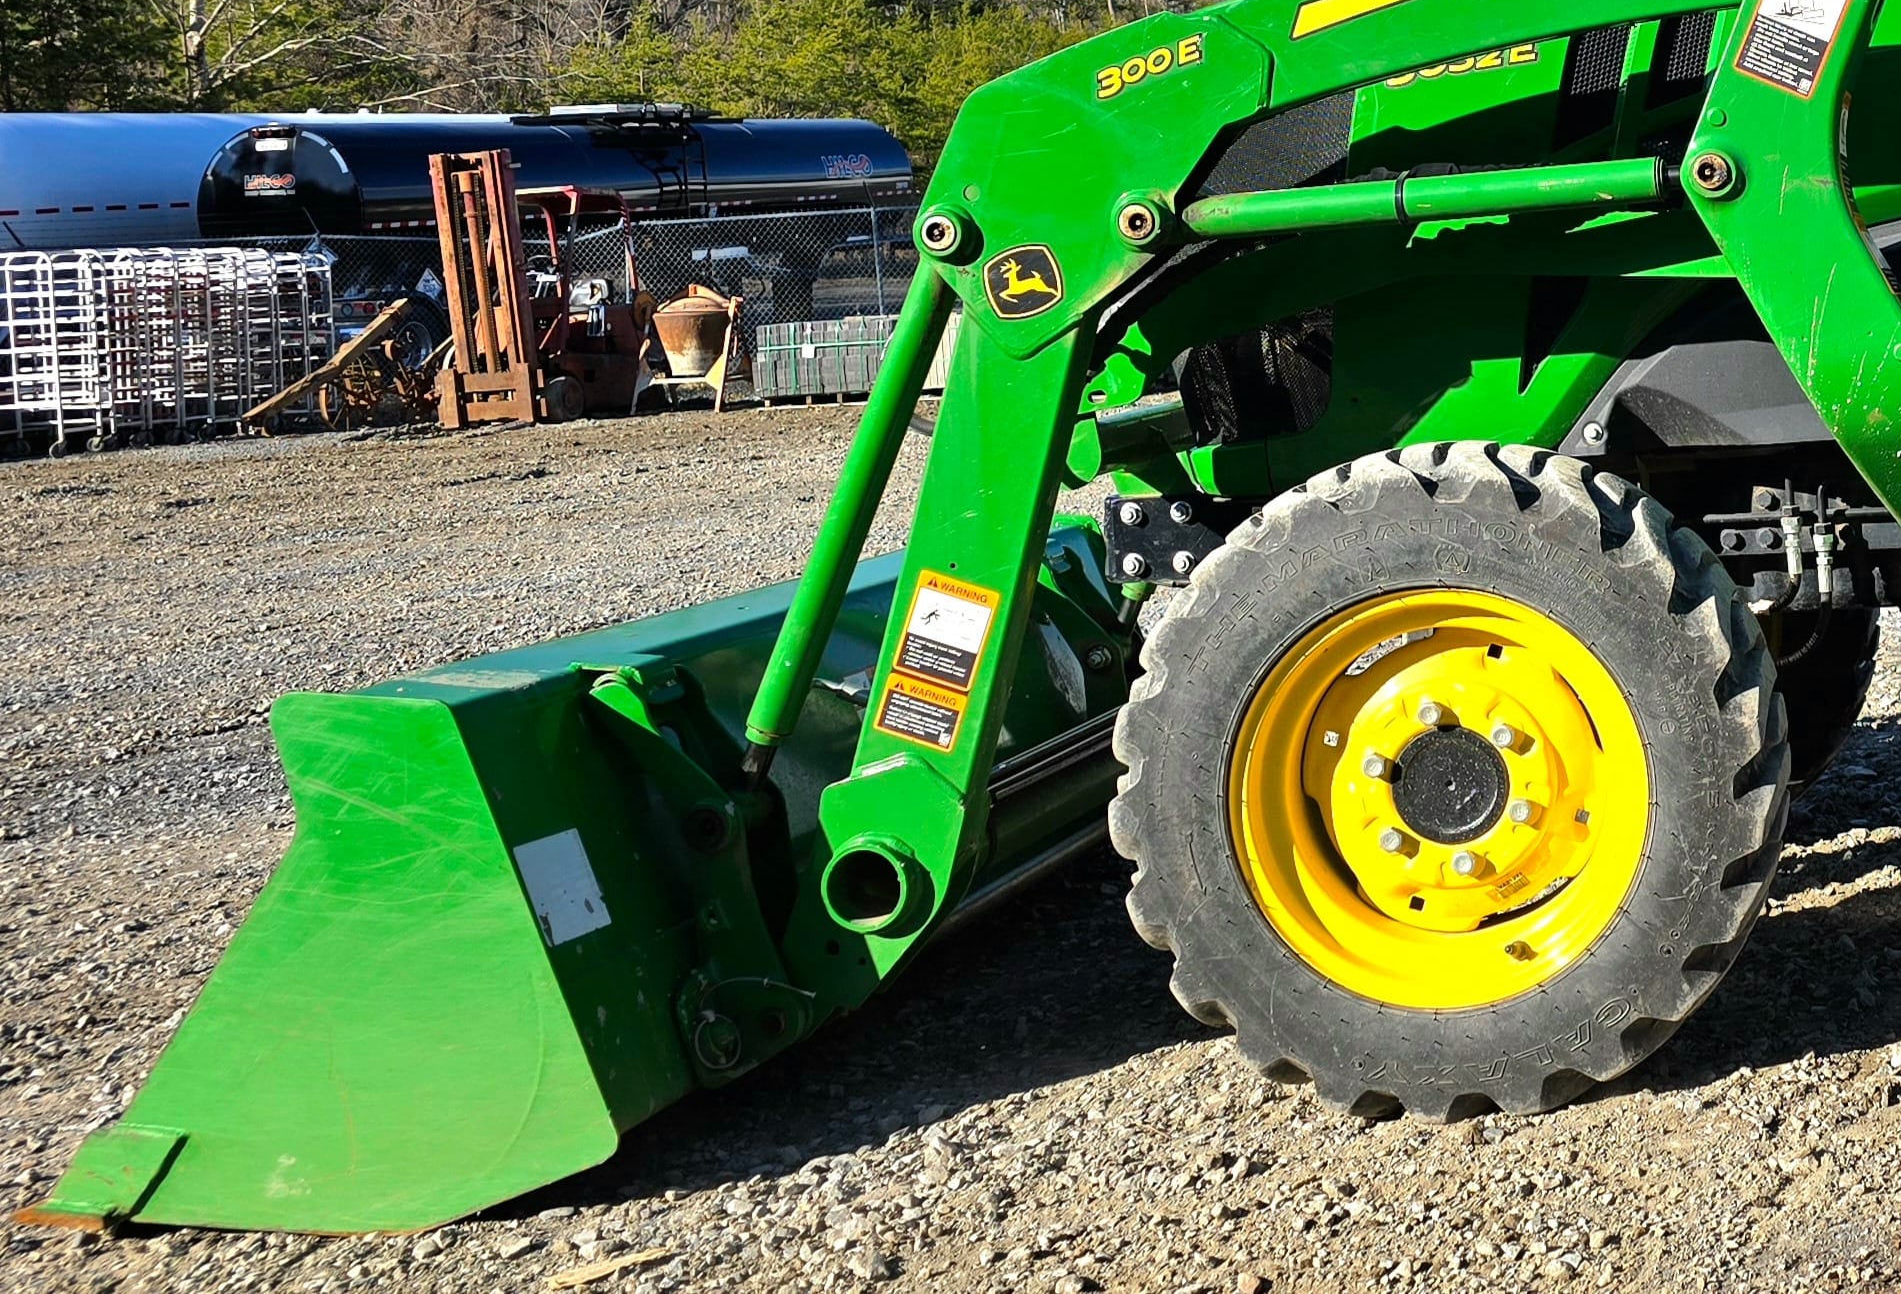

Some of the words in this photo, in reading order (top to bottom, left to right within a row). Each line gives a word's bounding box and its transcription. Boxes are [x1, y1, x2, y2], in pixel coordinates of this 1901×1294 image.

[939, 582, 988, 604] WARNING
[1186, 593, 1257, 676] THE
[1273, 515, 1613, 591] MARATHONER
[908, 684, 957, 707] WARNING
[1361, 997, 1632, 1083] GALAXY
